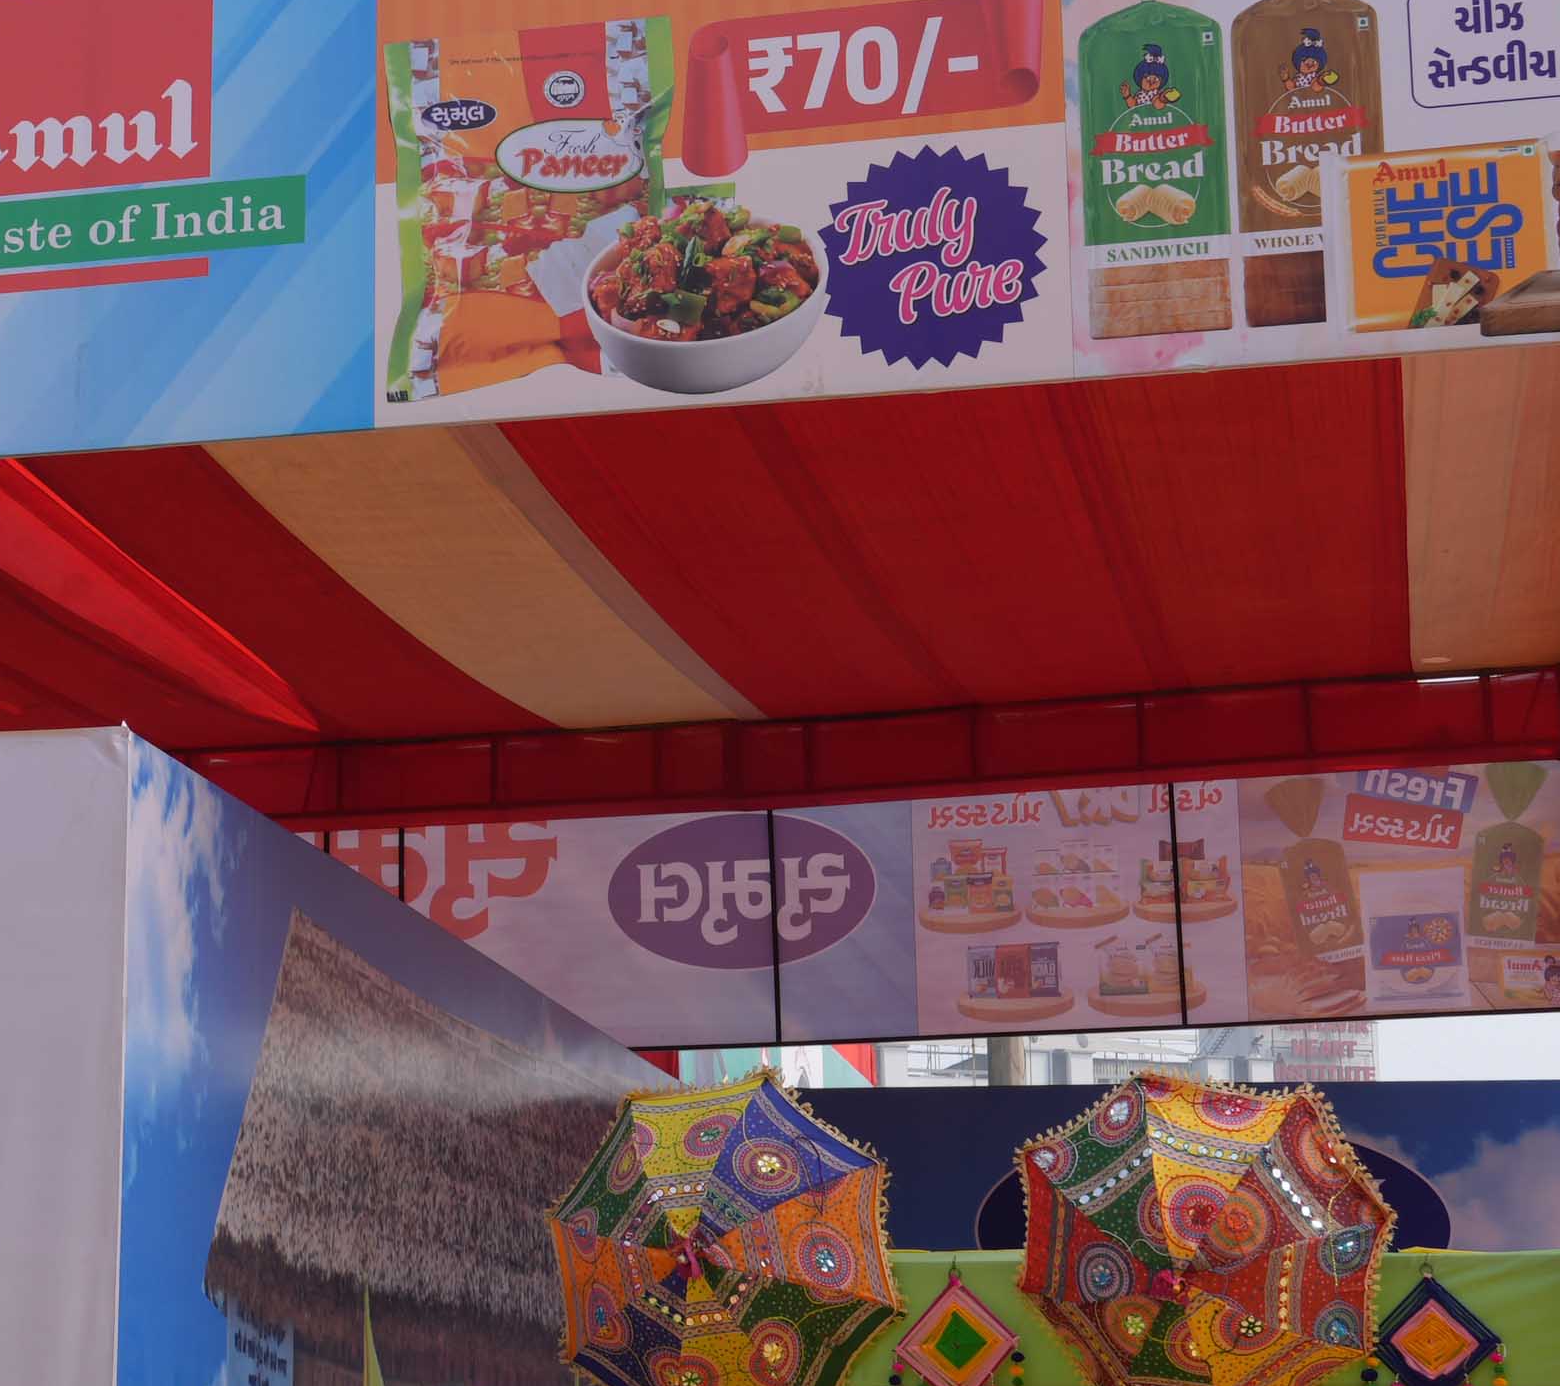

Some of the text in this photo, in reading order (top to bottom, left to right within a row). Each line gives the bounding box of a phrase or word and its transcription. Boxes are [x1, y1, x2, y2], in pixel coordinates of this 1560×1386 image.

[747, 16, 978, 114] ₹70/-
[1272, 108, 1348, 133] Butter
[1112, 127, 1190, 152] Butter
[1100, 152, 1206, 185] Bread
[1373, 158, 1447, 185] Amul
[83, 204, 139, 247] of
[149, 190, 289, 241] India
[834, 185, 976, 267] Truly
[1105, 241, 1210, 264] SANDWICH
[889, 249, 1024, 325] Pure
